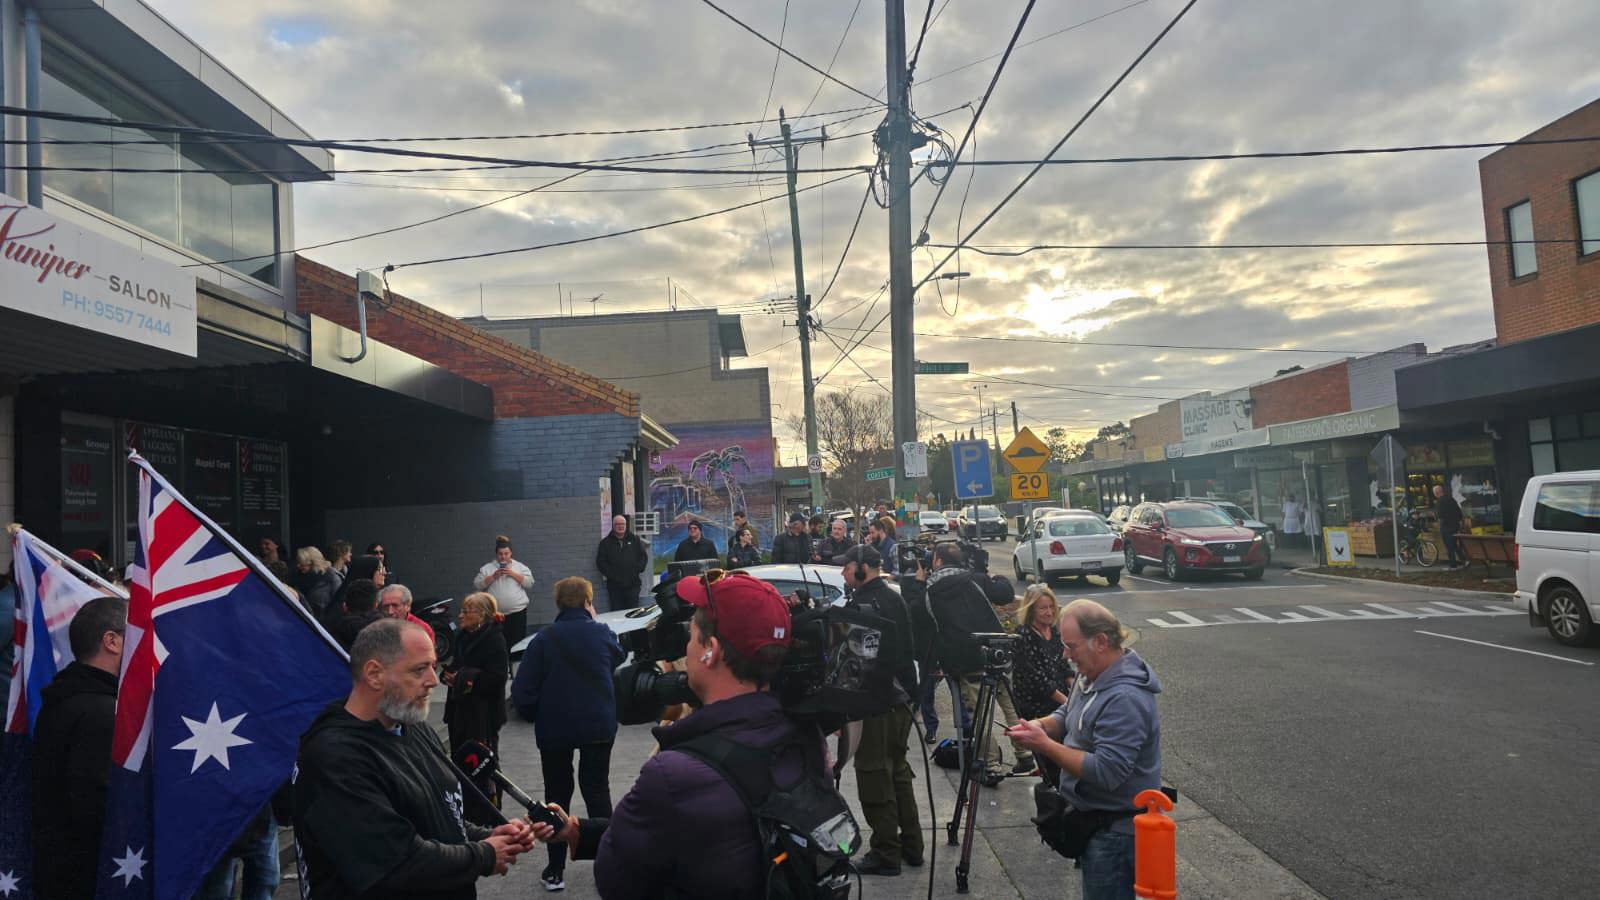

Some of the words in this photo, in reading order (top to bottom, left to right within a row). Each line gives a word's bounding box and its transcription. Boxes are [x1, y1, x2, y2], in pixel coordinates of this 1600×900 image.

[109, 275, 171, 310] SALON
[62, 291, 91, 314] PH:
[94, 300, 134, 324] 9557
[137, 313, 172, 337] 7444
[1184, 401, 1231, 424] MASSAGE
[1332, 415, 1376, 433] ORGANIC
[1184, 423, 1208, 437] CLINIC
[960, 444, 982, 473] P
[1018, 474, 1042, 490] 20
